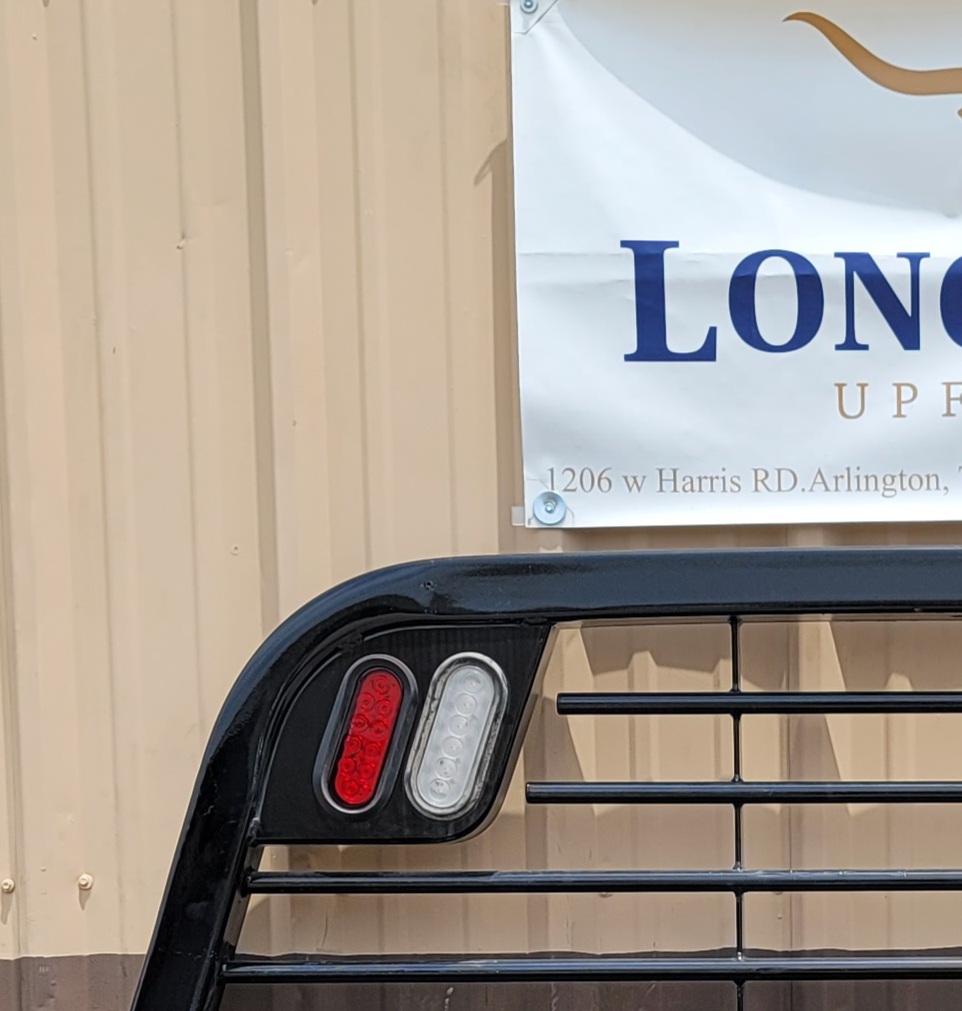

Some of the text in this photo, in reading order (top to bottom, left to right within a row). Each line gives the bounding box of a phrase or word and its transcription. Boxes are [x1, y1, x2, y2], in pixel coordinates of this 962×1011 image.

[547, 466, 613, 494] 1206
[622, 474, 648, 494] w
[655, 466, 742, 494] Harris
